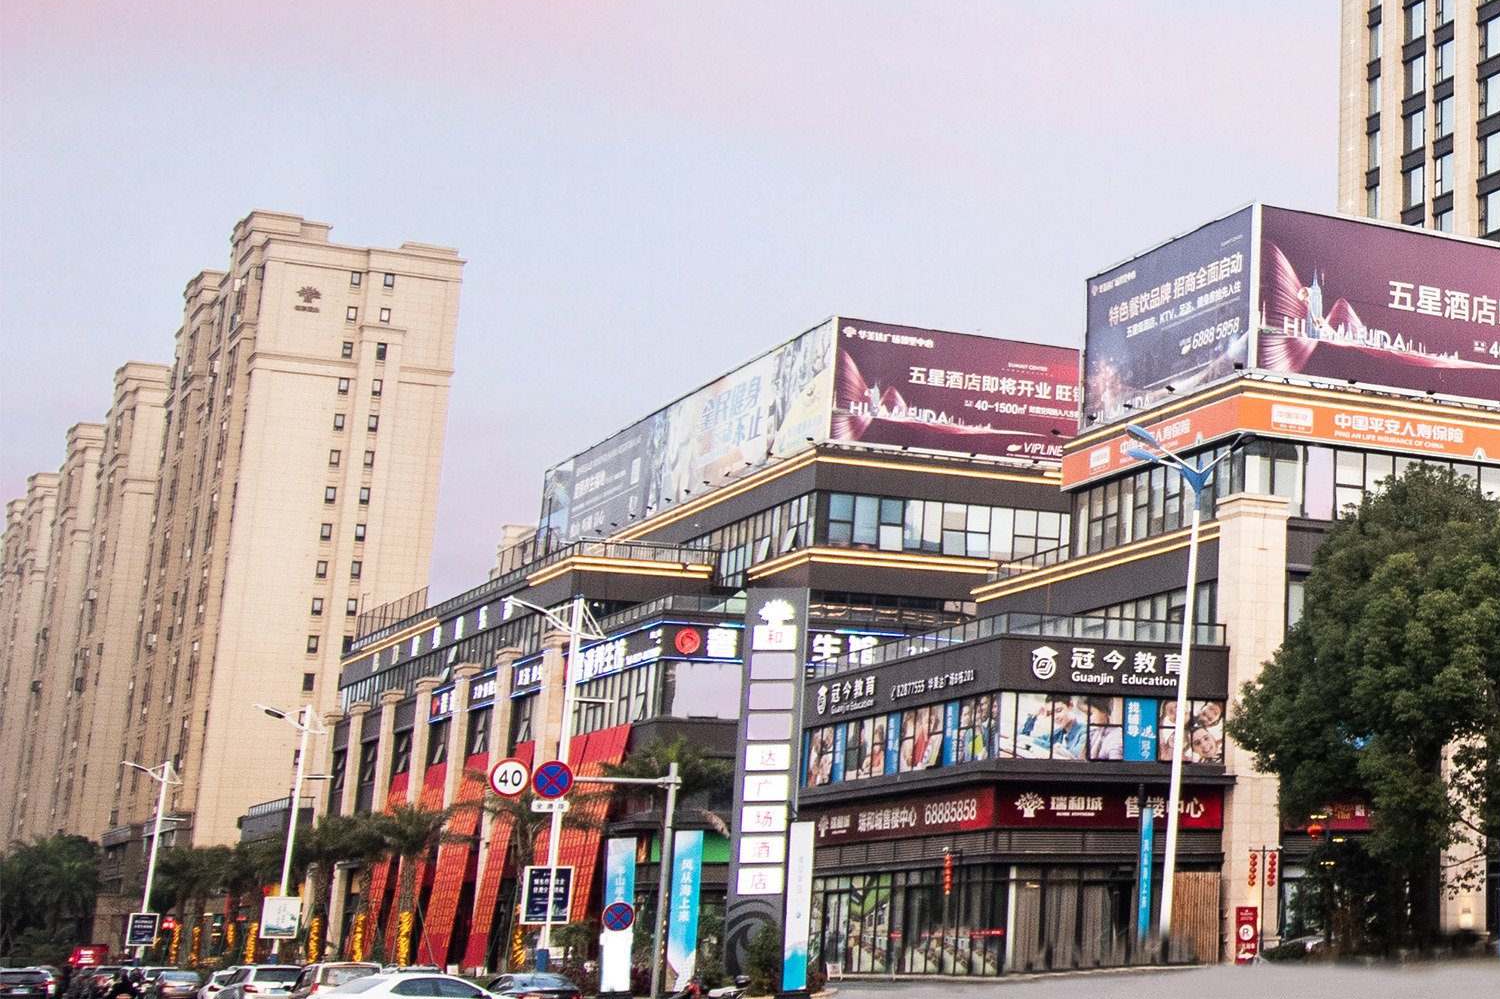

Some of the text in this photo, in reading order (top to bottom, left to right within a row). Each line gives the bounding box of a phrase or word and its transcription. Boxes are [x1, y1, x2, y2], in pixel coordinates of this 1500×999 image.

[1108, 282, 1172, 327] 特色餐饮品牌
[1173, 251, 1243, 299] 招商全面启动
[1215, 316, 1240, 340] 5858
[908, 366, 1052, 400] 五星酒店即将开业
[1120, 418, 1191, 454] 中国人寿保险
[1334, 413, 1464, 443] 中国平安人寿保险
[1334, 430, 1350, 439] PING
[1362, 433, 1376, 441] LIFE
[1377, 435, 1413, 446] INSURANCE
[1414, 439, 1424, 447] OF
[1424, 441, 1444, 449] CHINA
[768, 629, 783, 644] 和
[1070, 647, 1182, 675] 冠今教育
[831, 676, 876, 703] 冠今教育
[1071, 671, 1177, 687] Guanjin Education
[499, 769, 522, 787] 40
[925, 799, 977, 825] 68885858
[1050, 796, 1103, 811] 瑞和城
[750, 750, 777, 890] 达广场酒店
[677, 858, 693, 923] 风从海上来
